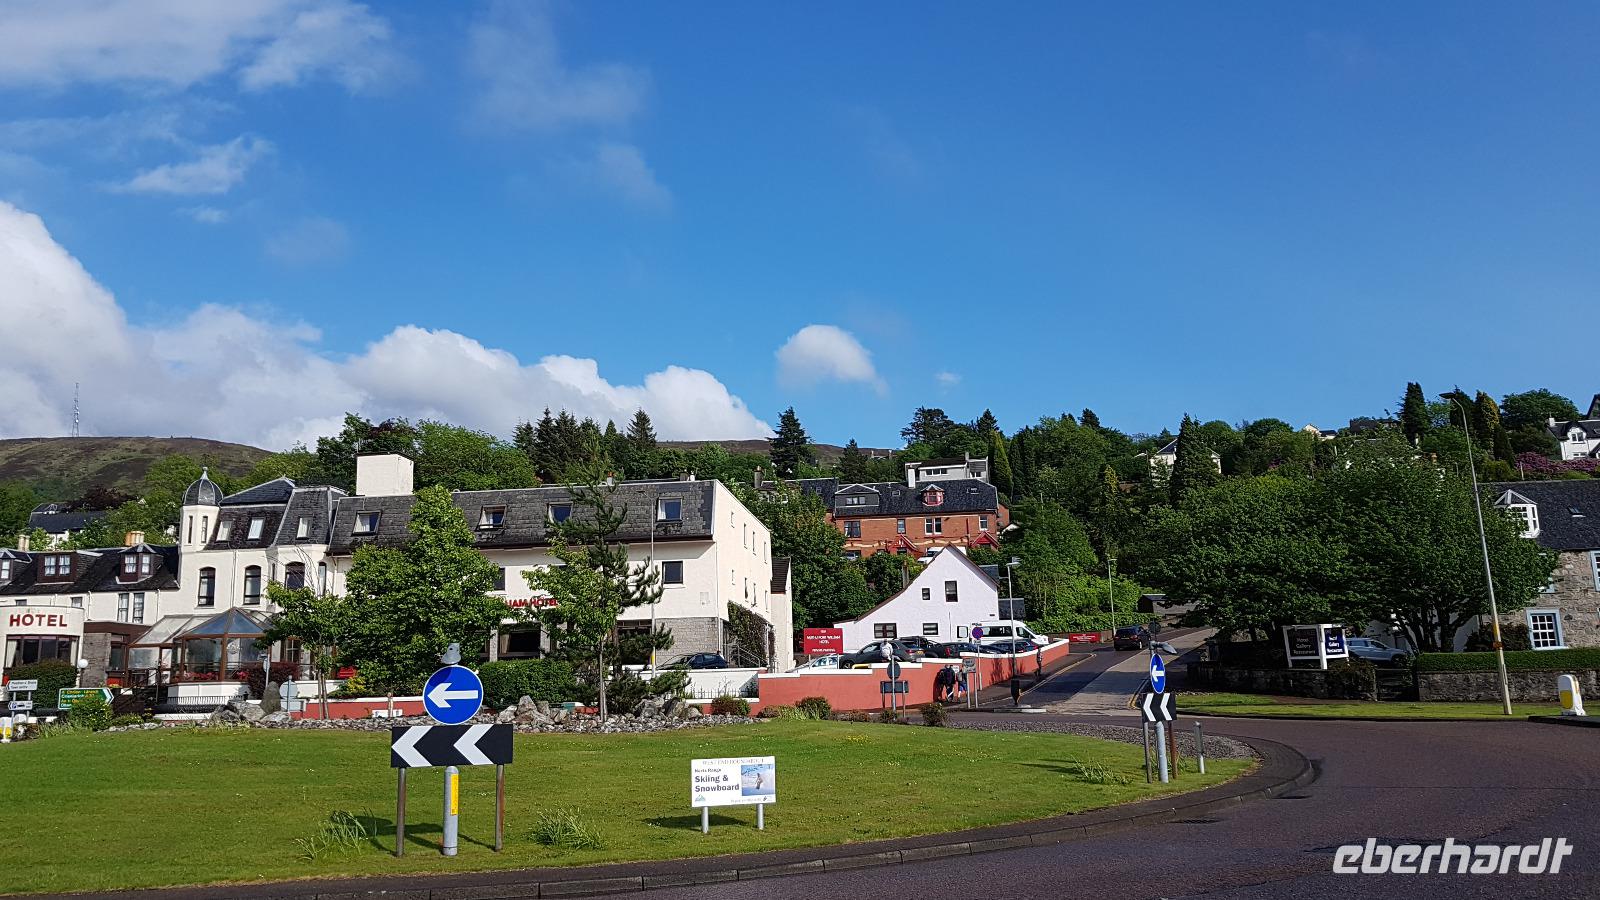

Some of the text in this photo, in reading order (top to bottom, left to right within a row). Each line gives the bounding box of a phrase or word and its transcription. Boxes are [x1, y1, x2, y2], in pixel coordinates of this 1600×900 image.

[9, 613, 68, 627] HOTEL
[694, 774, 729, 784] Skiing &
[694, 784, 740, 793] Snowboard
